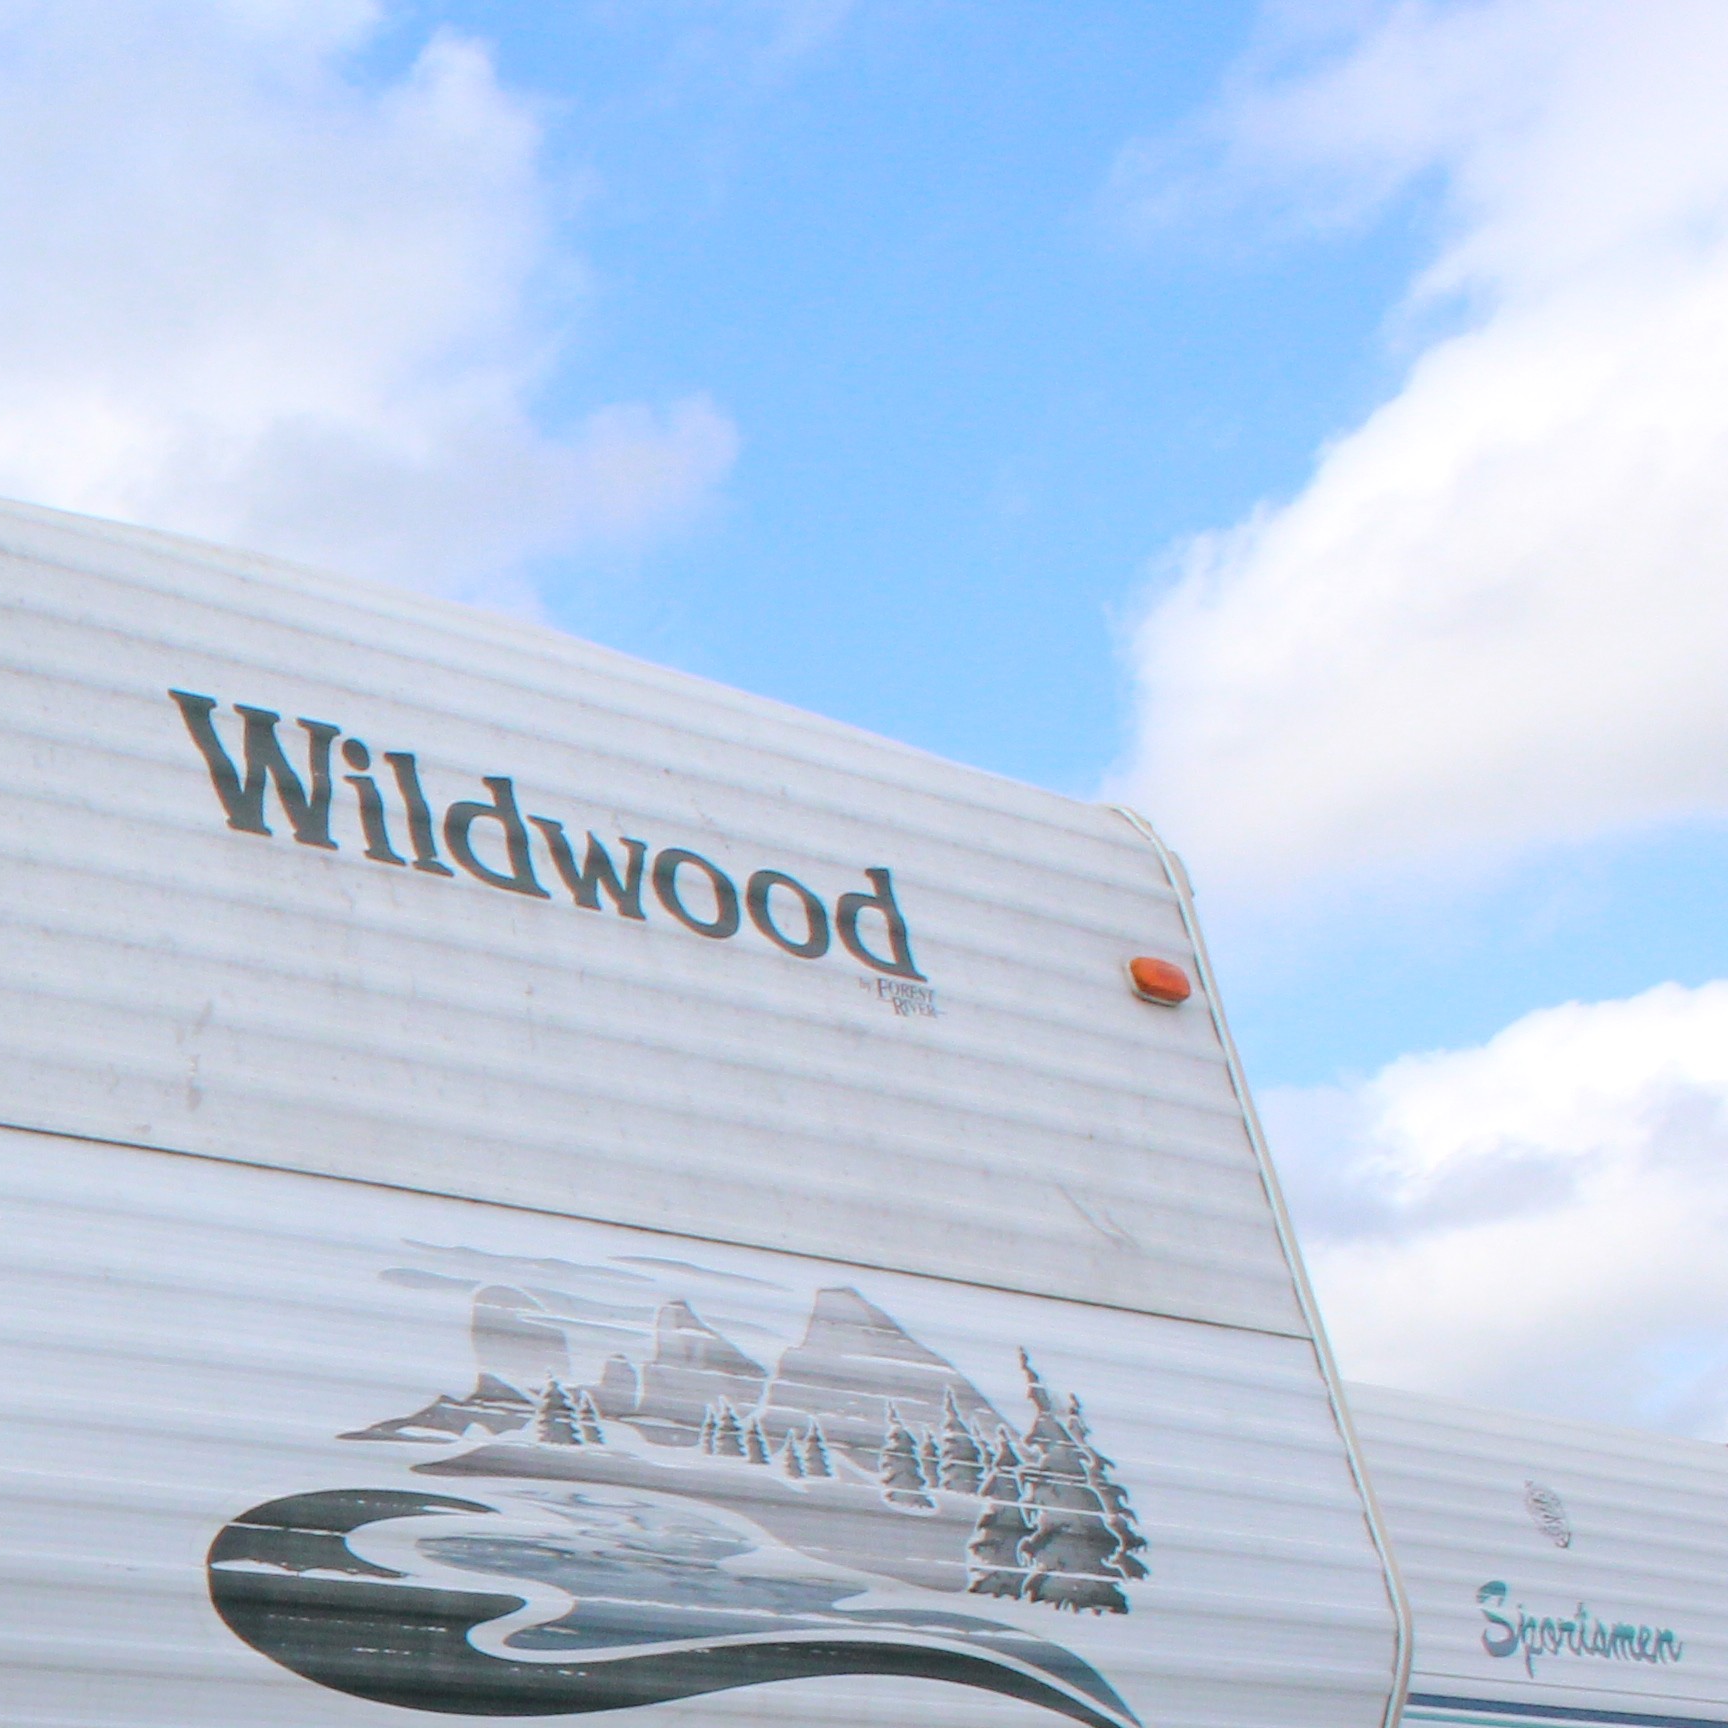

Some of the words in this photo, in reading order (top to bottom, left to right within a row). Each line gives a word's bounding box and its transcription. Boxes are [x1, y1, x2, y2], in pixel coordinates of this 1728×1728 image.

[168, 689, 929, 983] Wildwood
[877, 977, 935, 1003] FOREST
[1476, 1579, 1684, 1679] Sportsmen
